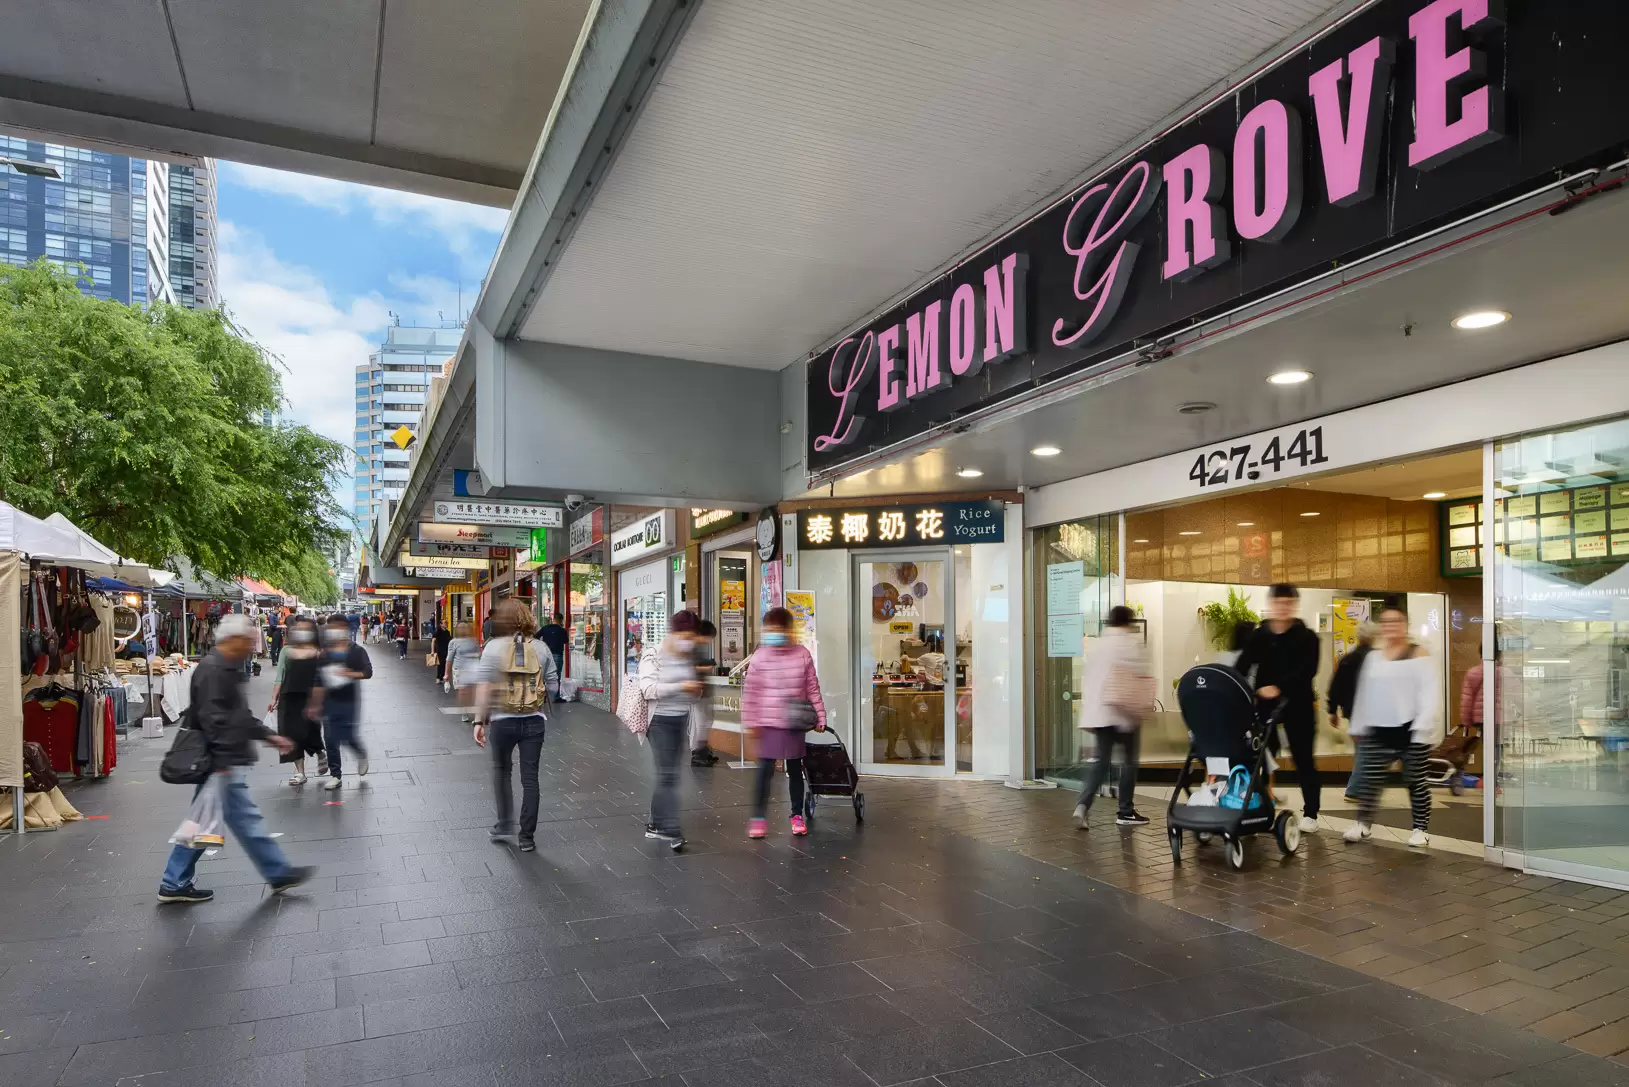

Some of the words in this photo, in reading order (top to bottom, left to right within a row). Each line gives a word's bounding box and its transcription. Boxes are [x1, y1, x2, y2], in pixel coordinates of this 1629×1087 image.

[814, 252, 1017, 452] LEMON
[1052, 0, 1489, 347] GROVE
[1189, 425, 1329, 488] 427-441
[806, 508, 944, 544] 泰椰奶花
[953, 523, 996, 537] Yogurt
[959, 508, 992, 520] Rice
